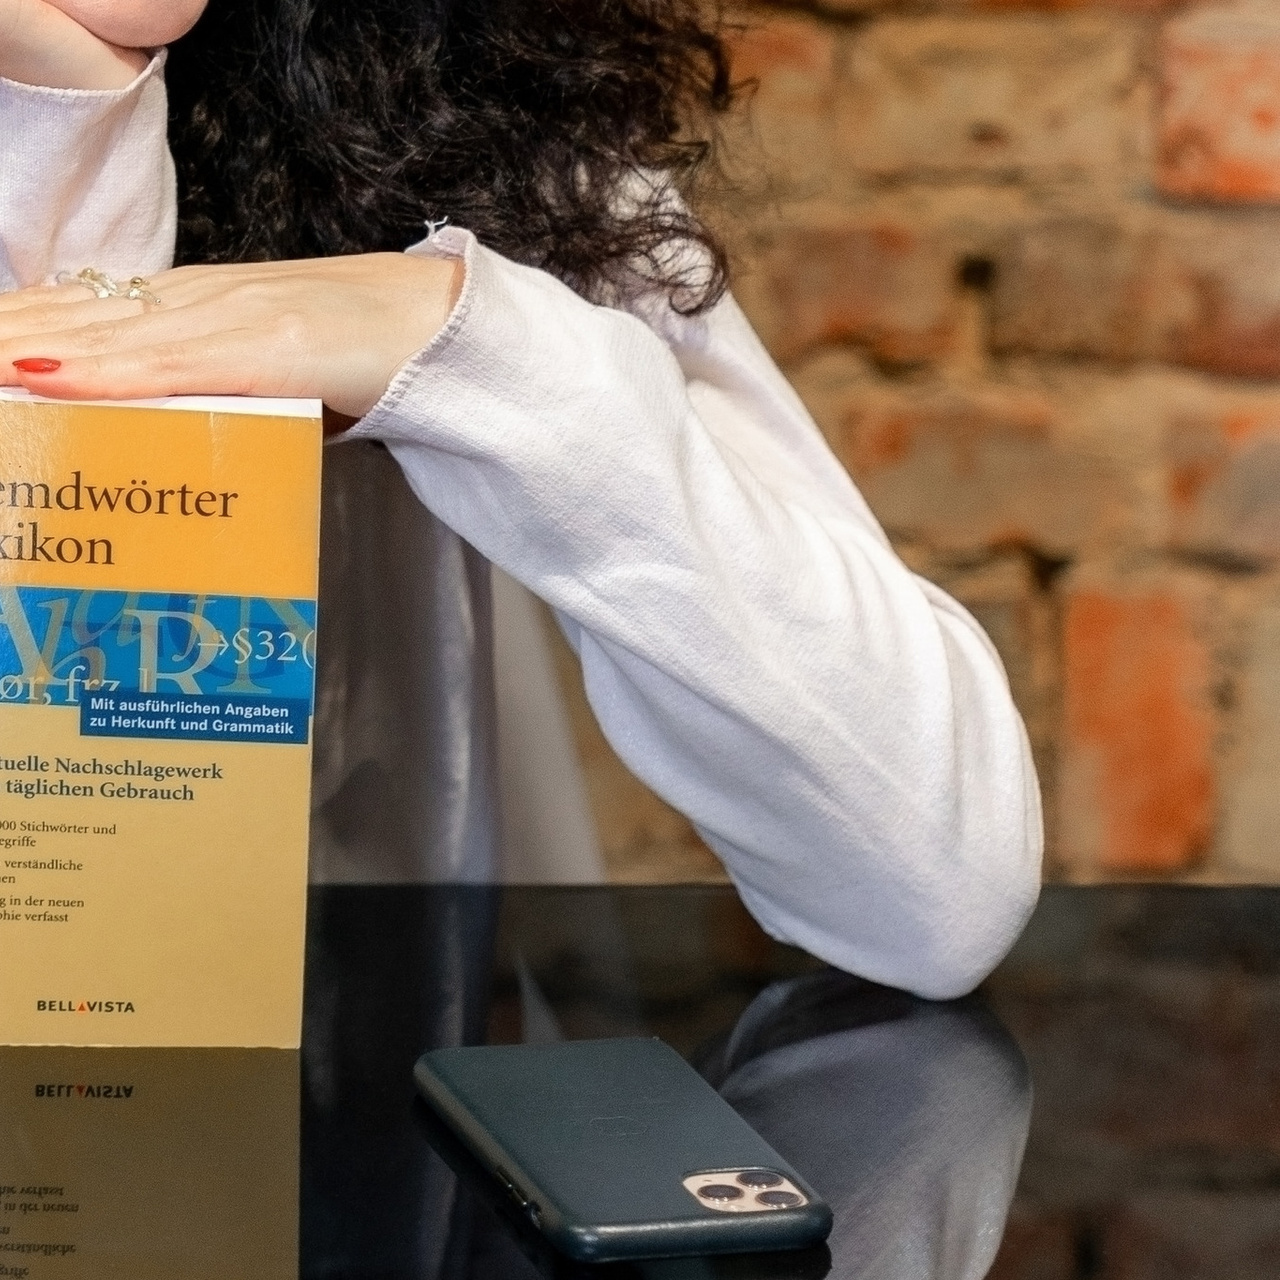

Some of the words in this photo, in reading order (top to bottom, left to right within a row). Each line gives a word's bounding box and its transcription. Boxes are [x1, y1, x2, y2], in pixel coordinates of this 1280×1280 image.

[91, 697, 115, 711] Mit
[119, 699, 220, 715] ausführlichen
[224, 703, 289, 719] Angaben
[89, 716, 106, 727] zu
[111, 715, 176, 730] Herkunft
[180, 719, 208, 731] und
[212, 719, 294, 735] Grammatik
[55, 757, 224, 782] Nachschlagewerk
[6, 778, 94, 799] täglichen
[100, 781, 195, 801] Gebrauch
[20, 820, 89, 834] Stichwörter
[93, 823, 117, 835] und
[4, 857, 83, 871] verständliche
[9, 894, 21, 906] in
[25, 895, 45, 907] der
[48, 898, 85, 908] neuen
[24, 910, 69, 923] verfasst
